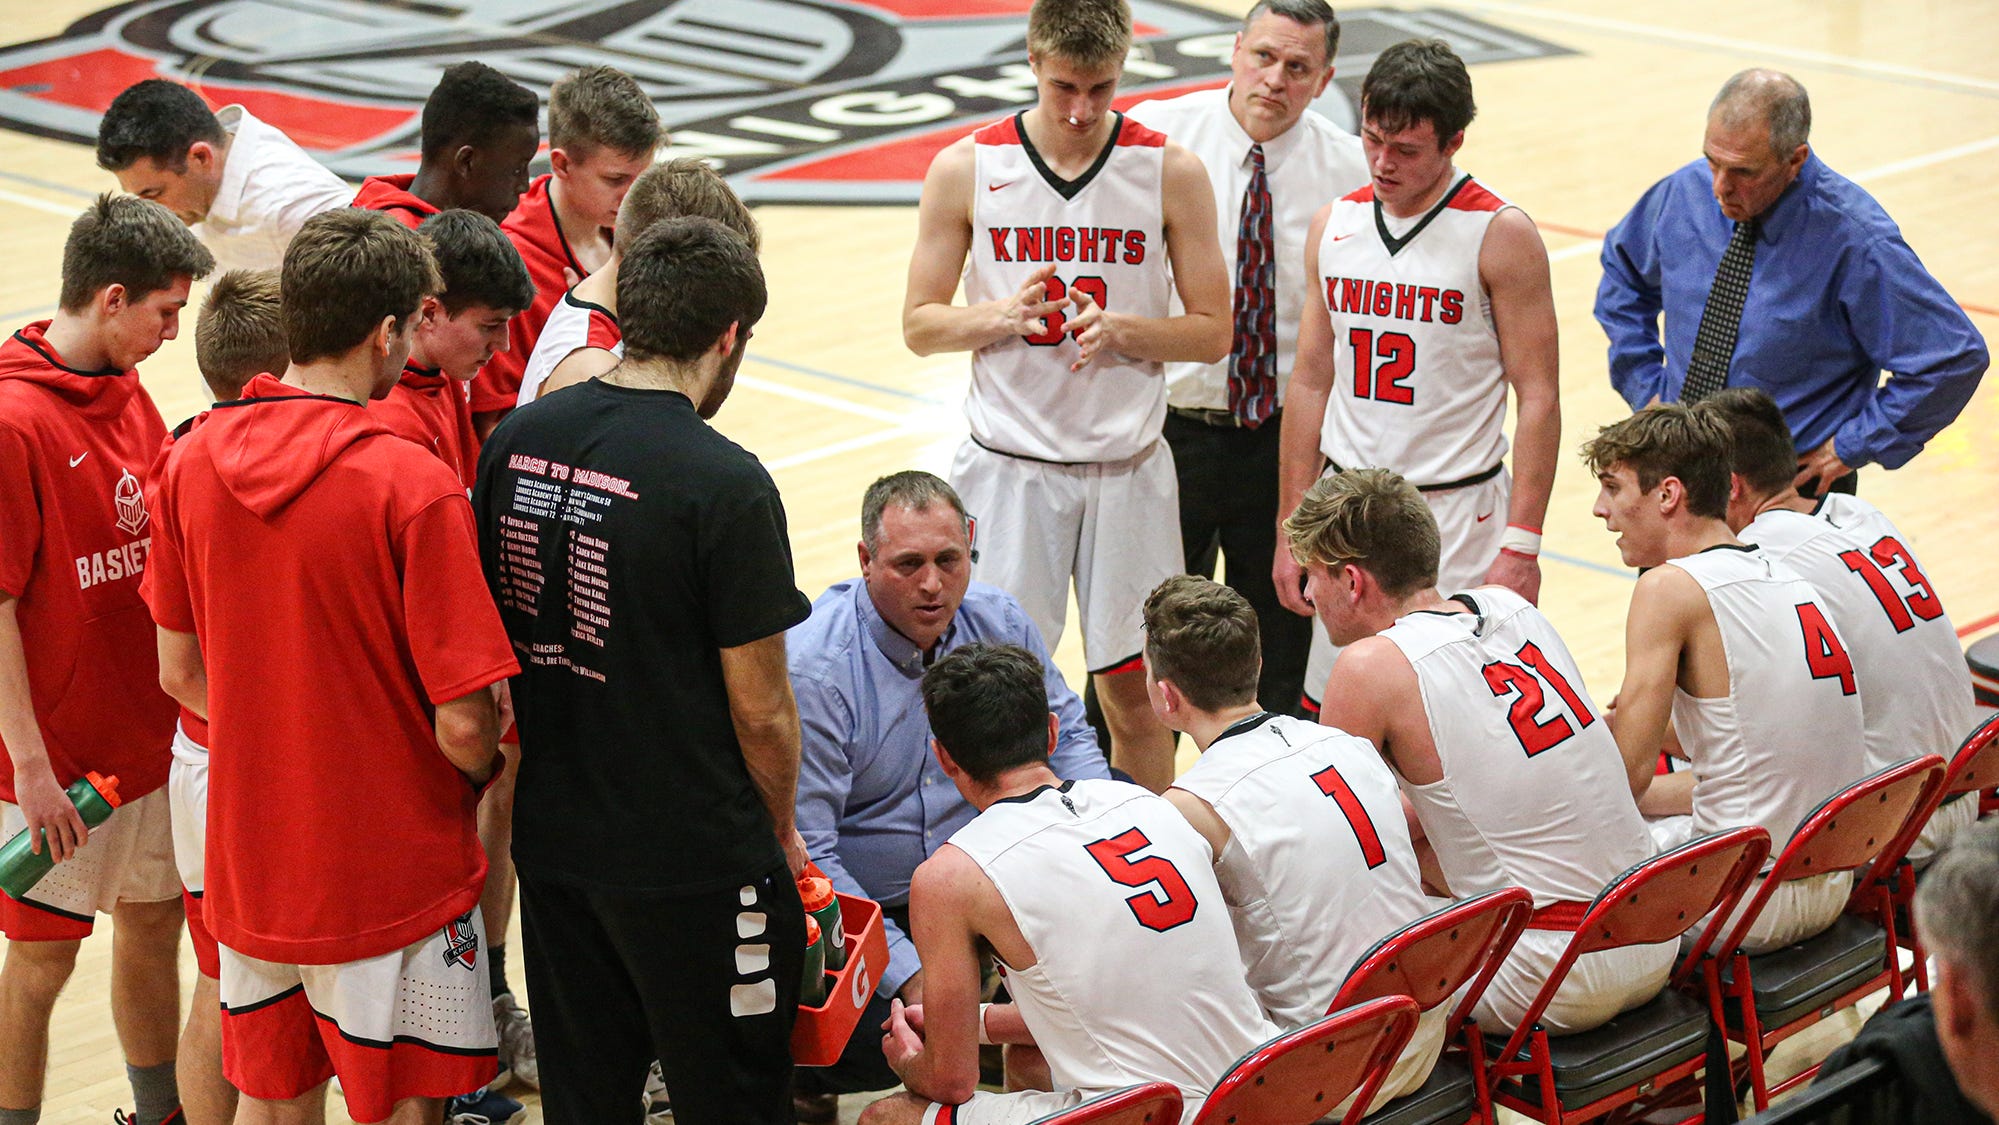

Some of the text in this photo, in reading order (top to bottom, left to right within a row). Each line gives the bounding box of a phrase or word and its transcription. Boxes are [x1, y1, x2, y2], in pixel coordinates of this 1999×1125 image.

[987, 226, 1146, 265] KNIGHTS
[1325, 276, 1465, 325] KNIGHTS
[1349, 327, 1416, 406] 12
[508, 454, 548, 476] MARCH
[550, 463, 570, 481] TO
[533, 480, 554, 492] ACADEMY
[528, 505, 549, 518] ACADEMY
[548, 510, 556, 520] 72
[530, 497, 551, 509] ACADEMY
[531, 488, 552, 500] ACADEMY
[75, 537, 152, 590] BASKET
[1837, 535, 1945, 634] 13
[1794, 601, 1857, 697] 4
[1481, 639, 1596, 758] 21
[1309, 764, 1387, 870] 1
[1083, 826, 1198, 933] 5
